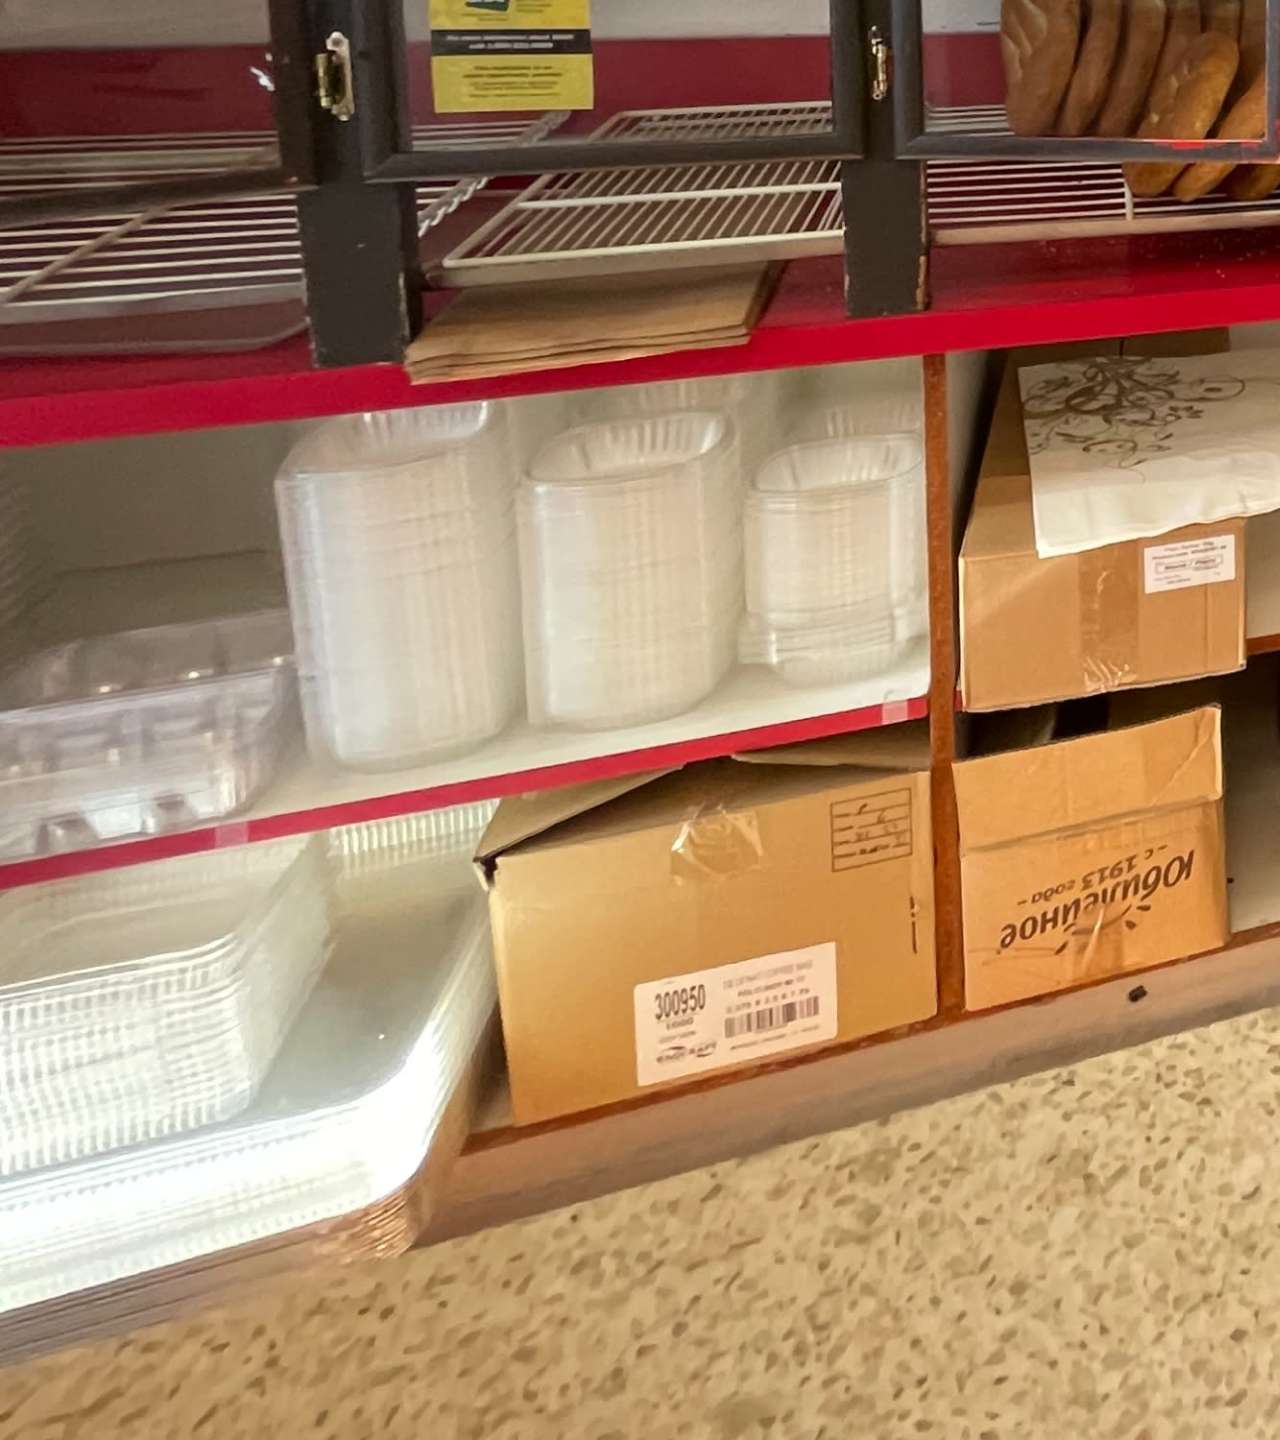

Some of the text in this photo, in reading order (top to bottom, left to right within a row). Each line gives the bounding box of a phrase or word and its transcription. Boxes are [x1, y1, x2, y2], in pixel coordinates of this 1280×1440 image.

[1081, 856, 1138, 892] 1913
[999, 849, 1196, 950] Юбилейное
[655, 984, 706, 1021] 300950
